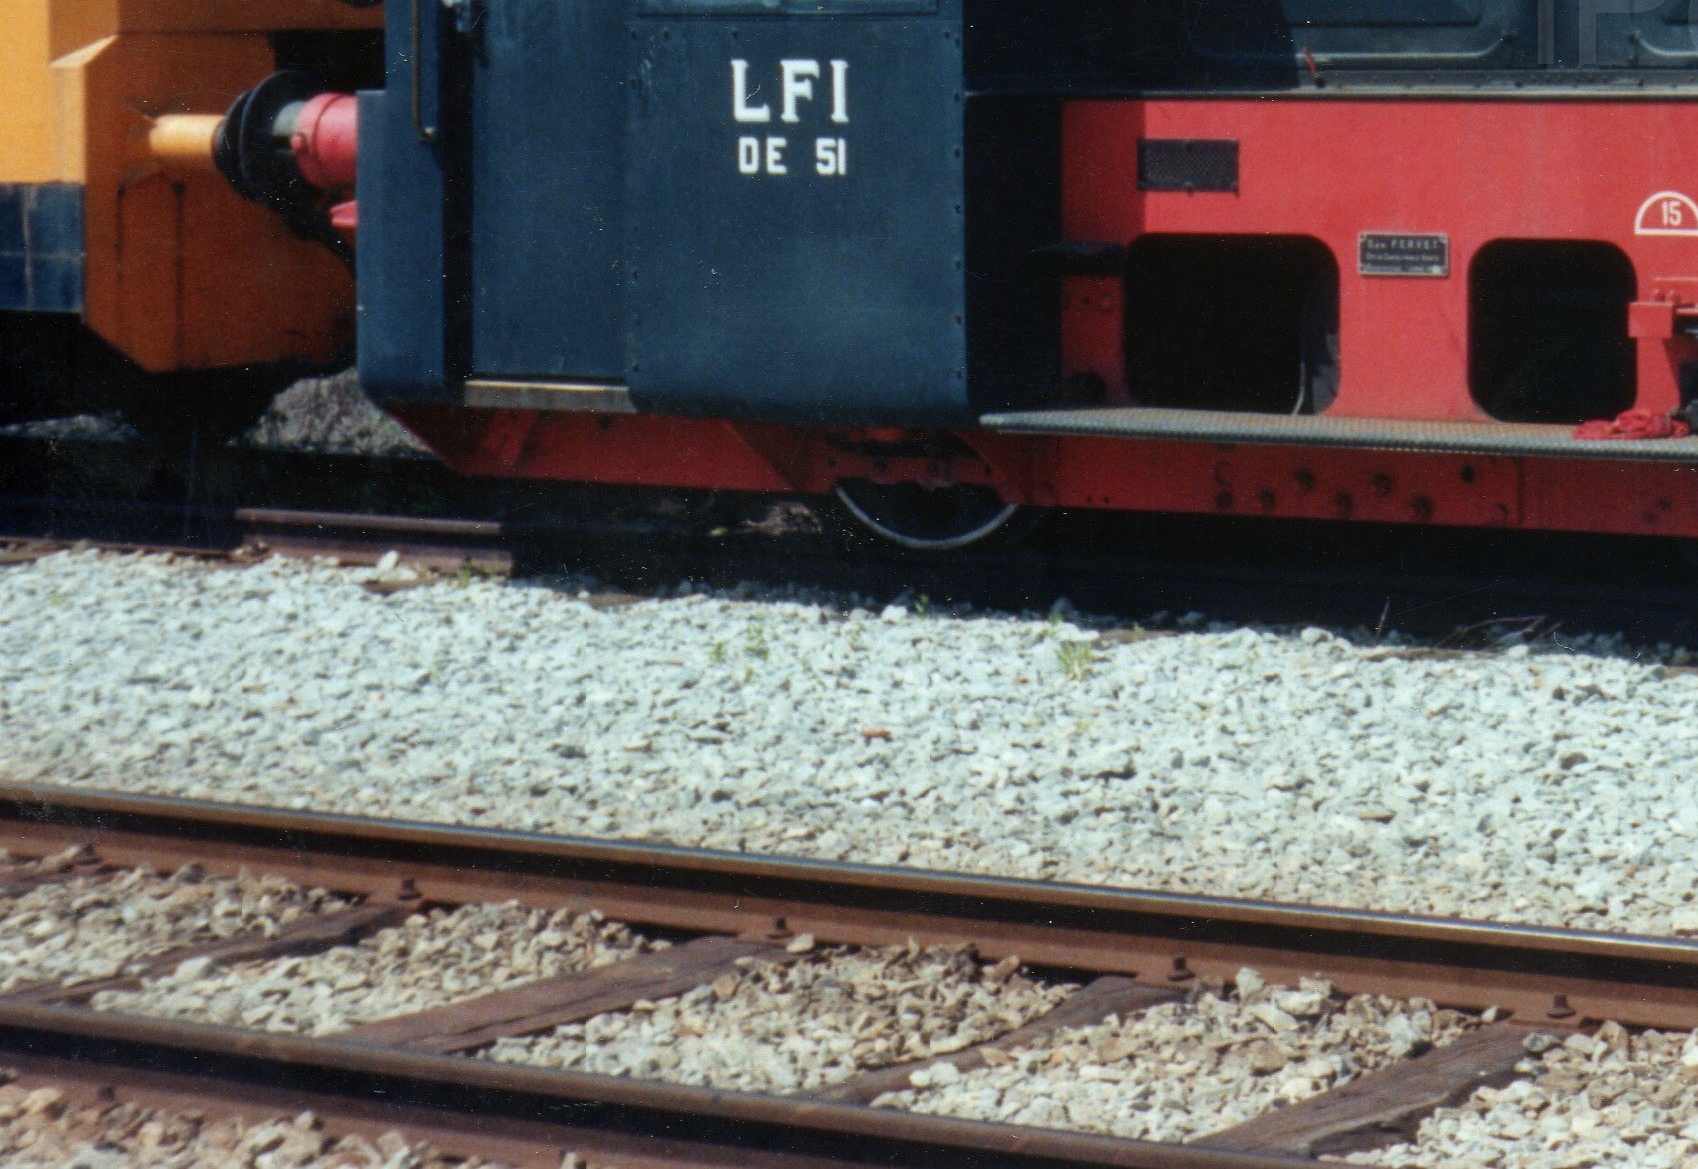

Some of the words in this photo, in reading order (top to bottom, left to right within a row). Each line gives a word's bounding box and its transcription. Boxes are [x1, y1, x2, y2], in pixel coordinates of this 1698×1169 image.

[730, 58, 850, 123] LFI
[738, 135, 788, 175] DE
[815, 136, 847, 176] 51
[1661, 200, 1683, 226] 15
